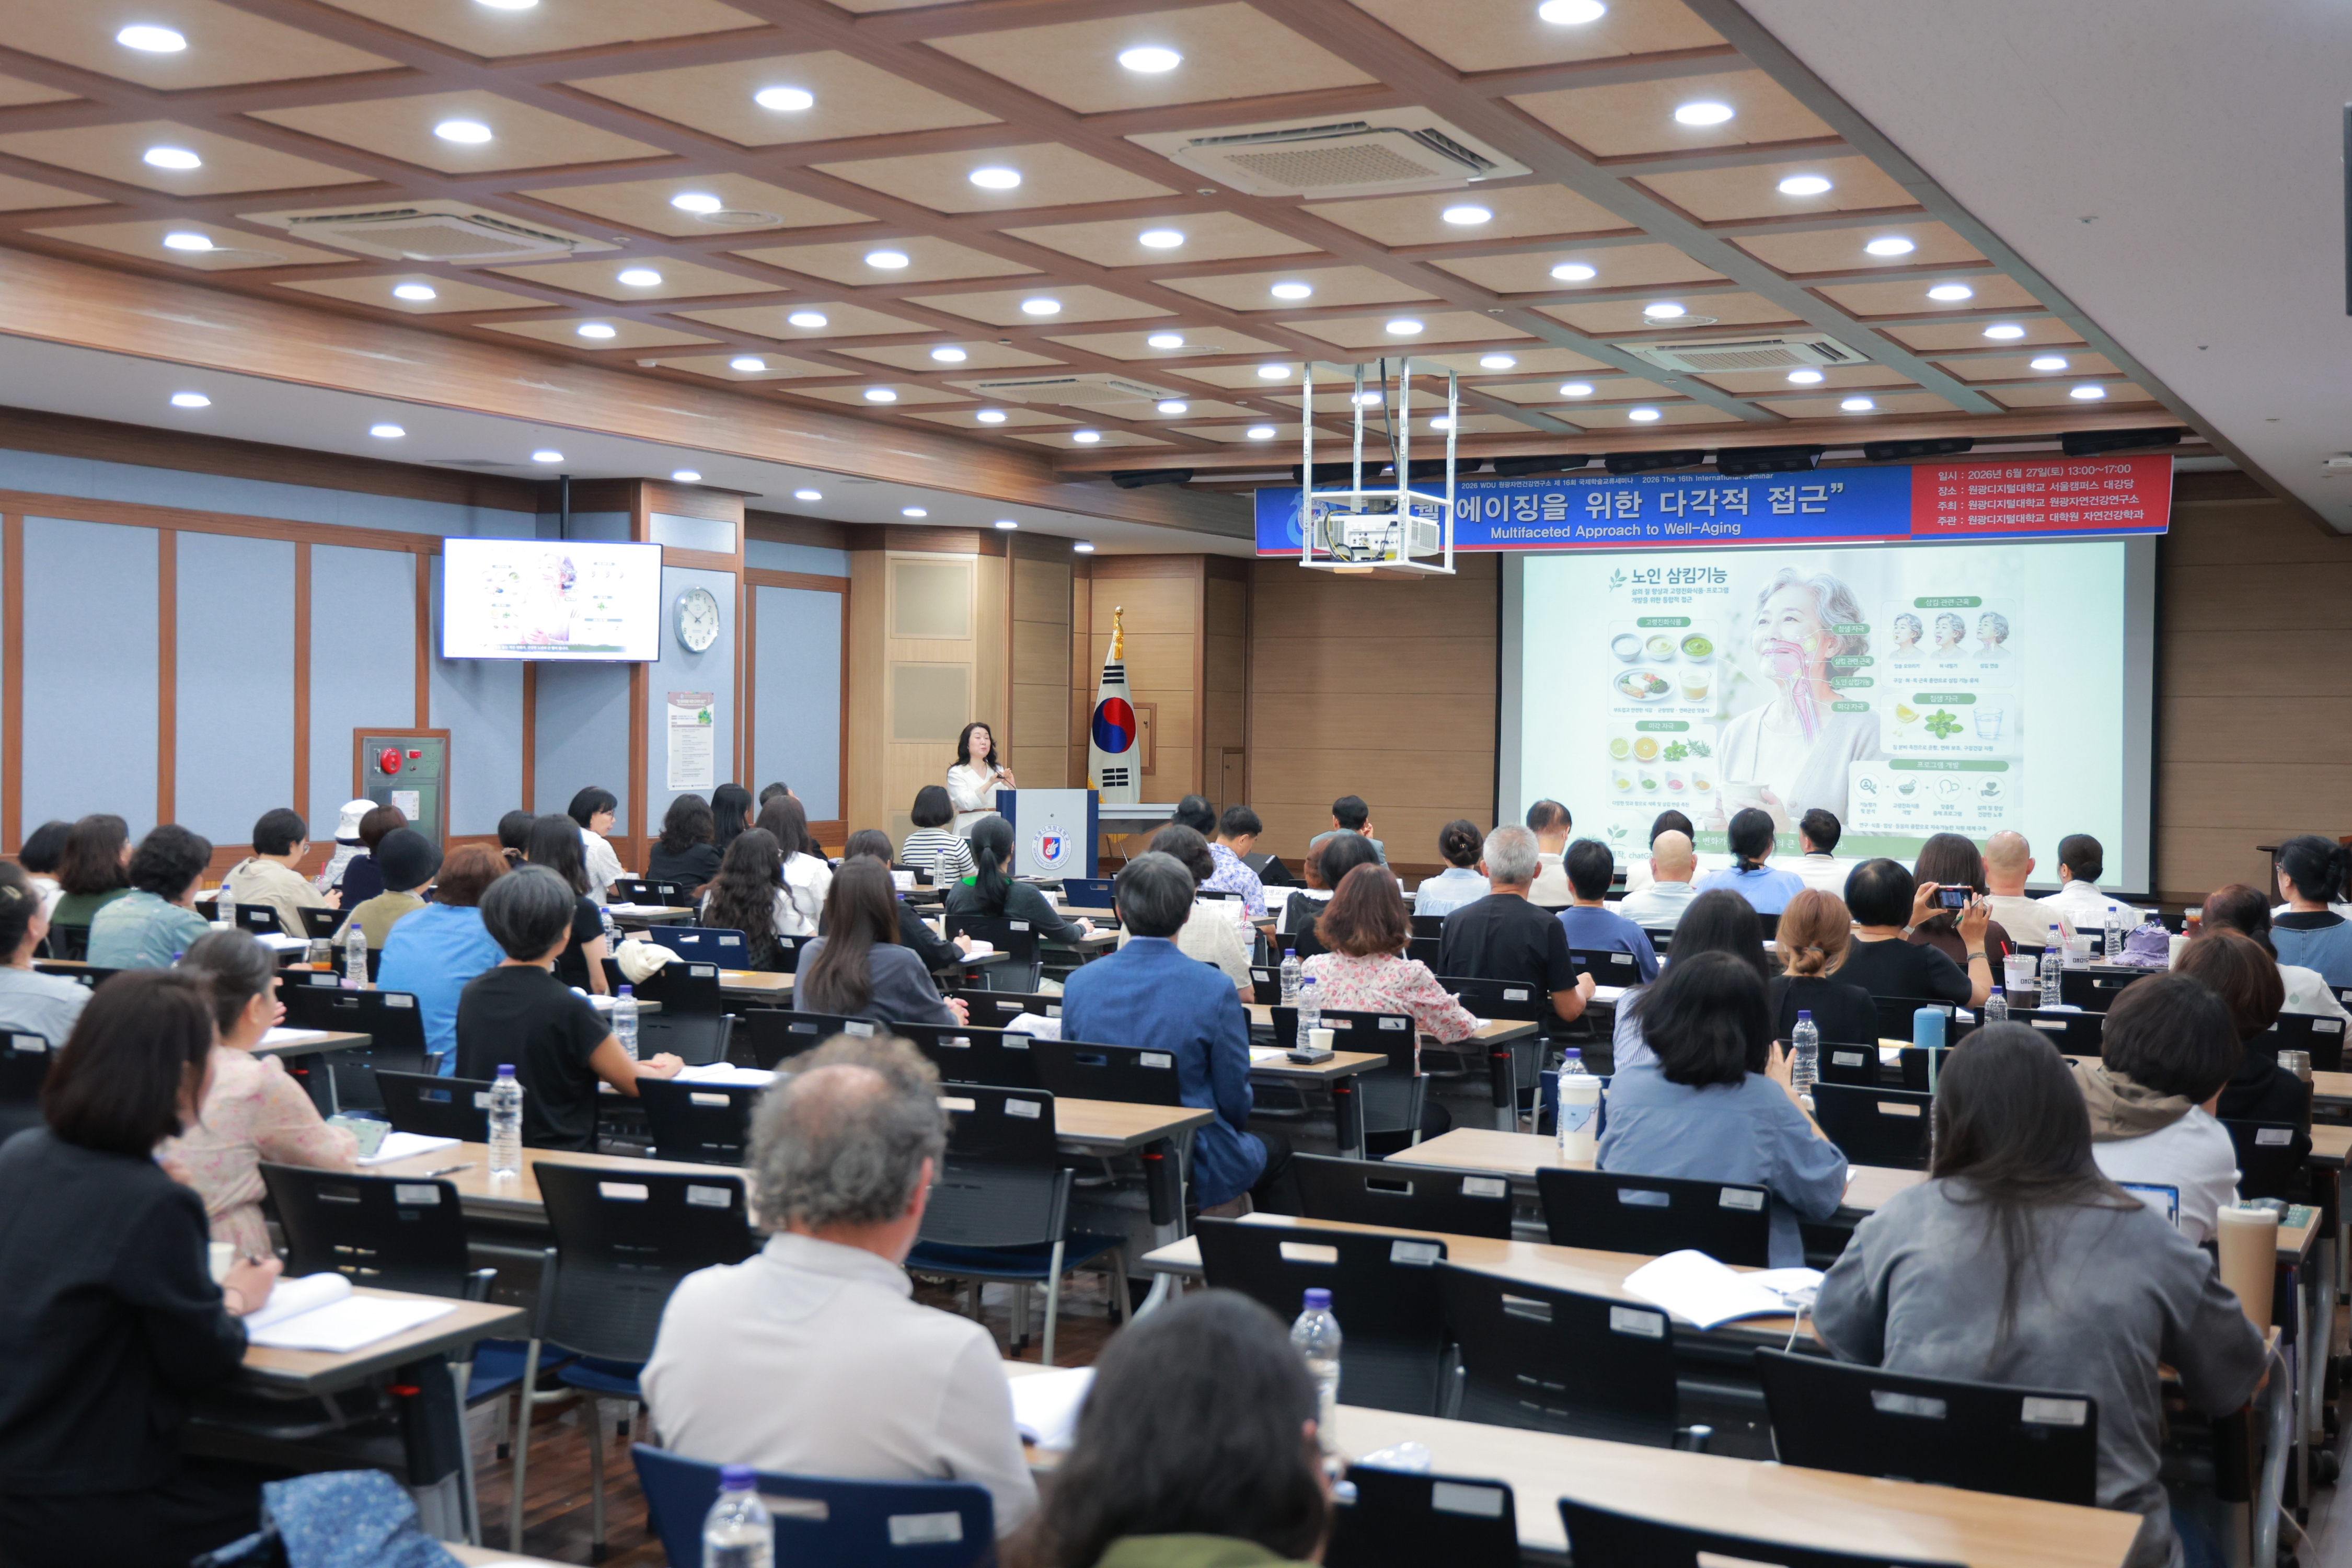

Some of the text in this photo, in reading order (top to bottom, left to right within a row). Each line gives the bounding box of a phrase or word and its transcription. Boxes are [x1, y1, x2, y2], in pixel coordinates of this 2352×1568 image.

[1938, 471, 1957, 481] 일시
[1968, 469, 2001, 480] 2026년
[2005, 468, 2022, 479] 6월
[2026, 466, 2063, 477] 27일(토)
[2068, 464, 2131, 476] 13:00~17:00
[1578, 477, 1633, 486] 국제학술교류세미나
[1938, 486, 1957, 497] 장소
[1968, 482, 2045, 495] 원광디지털대학교
[2049, 480, 2099, 492] 서울캠퍼스
[2104, 478, 2134, 490] 대강당
[1456, 493, 1569, 523] 에이징을
[1585, 491, 1642, 520] 위한
[1660, 487, 1749, 517] 다각적
[1767, 482, 1843, 515] 접근”
[1938, 501, 1957, 512] 주최
[1968, 497, 2045, 510] 원광디지털대학교
[2049, 494, 2139, 508] 원광자연건강연구소
[1937, 516, 1957, 526] 주관
[1967, 512, 2045, 525] 원광디지털대학교
[2049, 511, 2079, 522] 대학원
[2083, 509, 2144, 522] 자연건강학과
[1491, 522, 1741, 539] Multifaceted Approach to Well-Aging
[1631, 567, 1727, 584] 노인 삼킴기능
[1034, 825, 1069, 841] 원광디지털대학교
[1786, 839, 1795, 849] 큰
[1033, 847, 1044, 866] WONKWANG
[1058, 847, 1070, 866] UNIVERSITY
